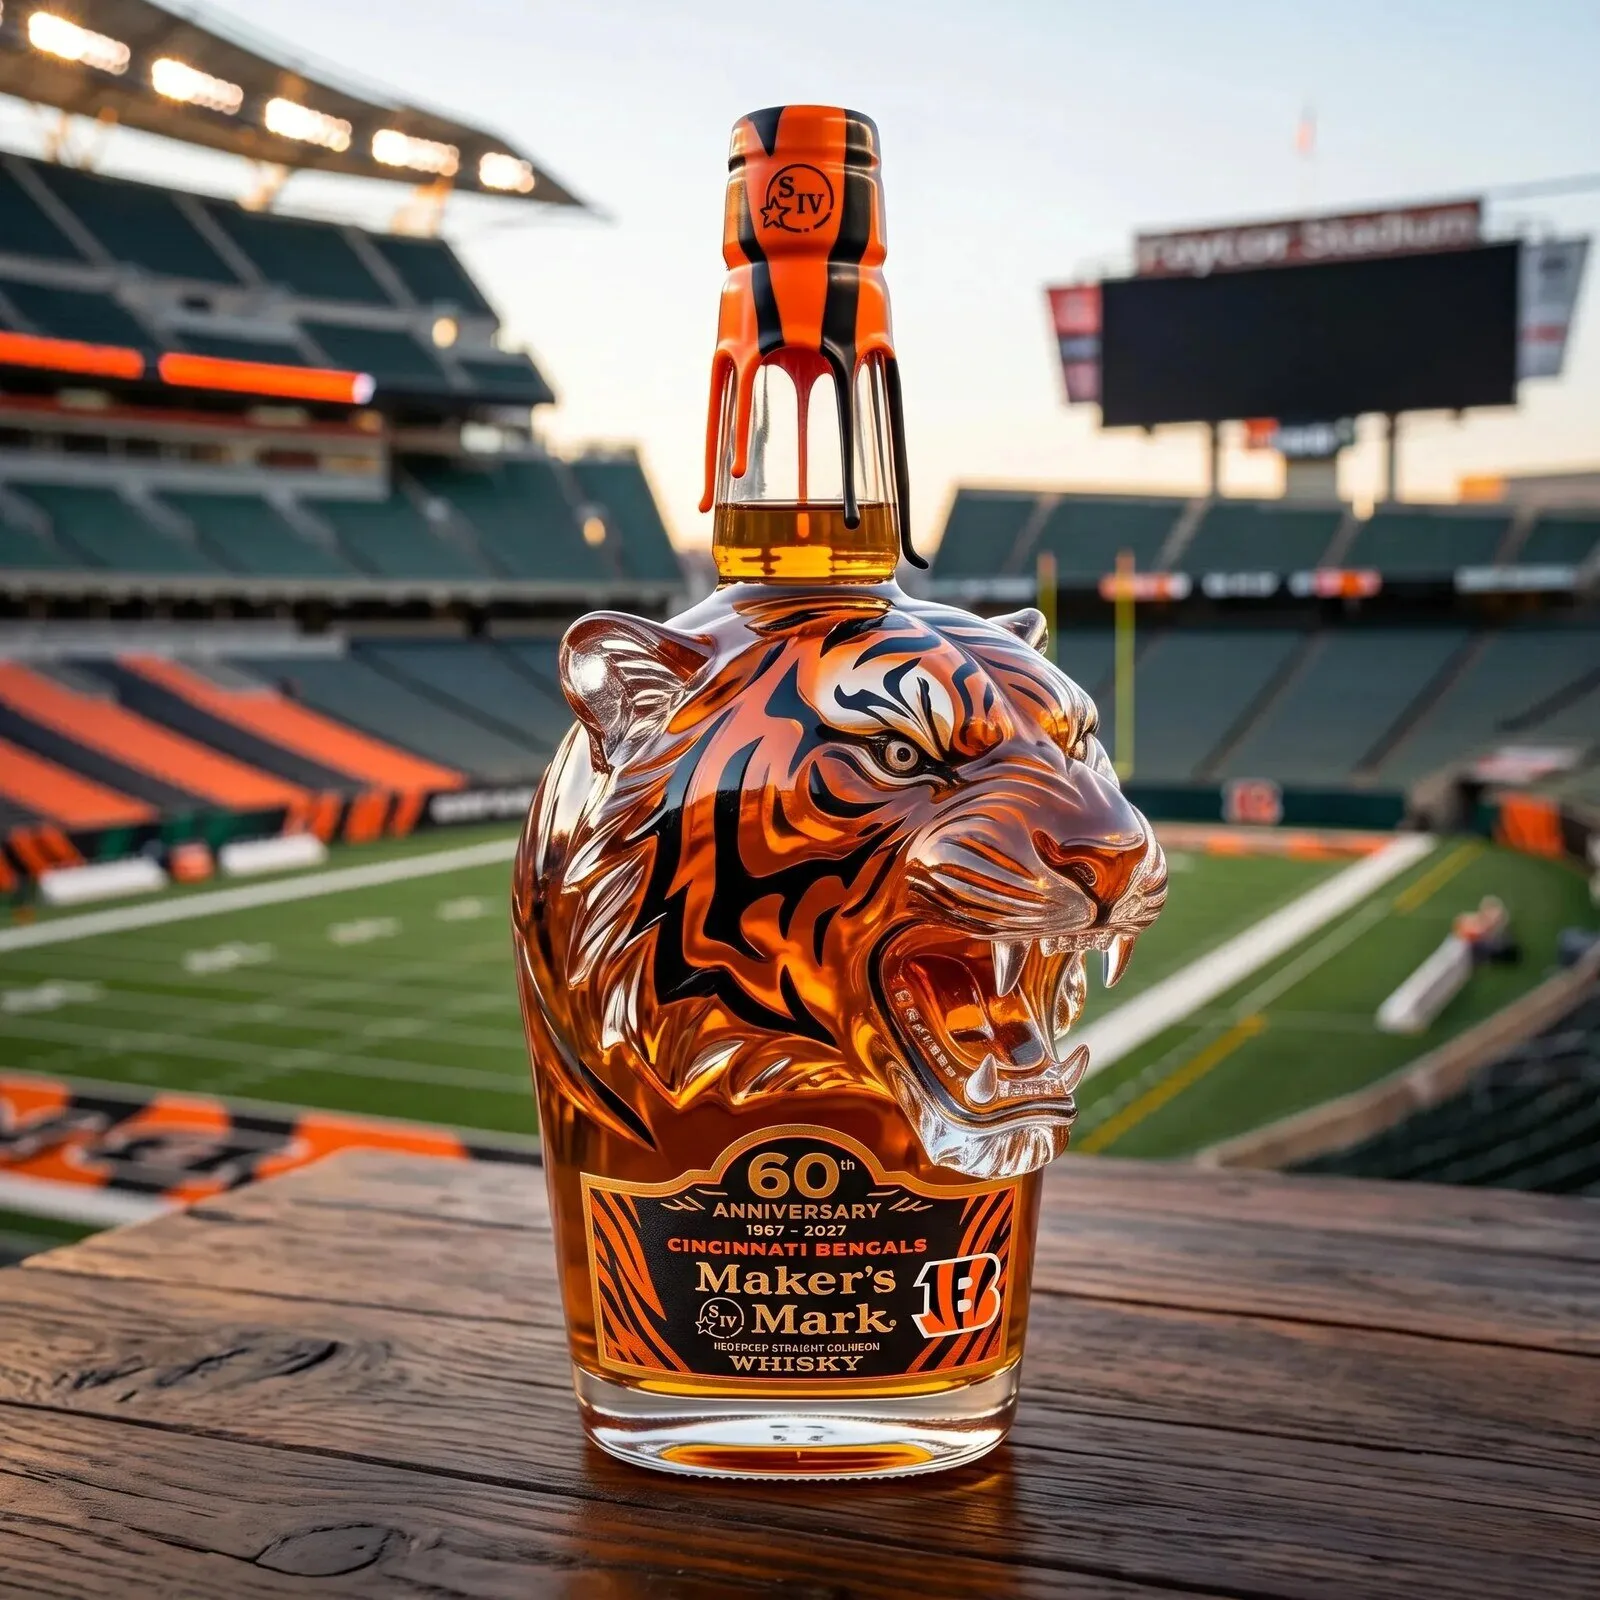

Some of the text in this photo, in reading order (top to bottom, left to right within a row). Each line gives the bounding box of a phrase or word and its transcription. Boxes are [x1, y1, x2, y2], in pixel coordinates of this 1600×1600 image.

[778, 176, 795, 198] S
[796, 193, 825, 215] IV
[712, 1202, 882, 1220] ANNIVERSARY
[746, 1224, 785, 1237] 1967
[804, 1225, 847, 1237] 2027
[667, 1238, 928, 1257] CINCINNATI BENGALS
[694, 1261, 897, 1296] Maker's
[709, 1305, 719, 1318] S
[729, 1355, 864, 1372] WHISKY
